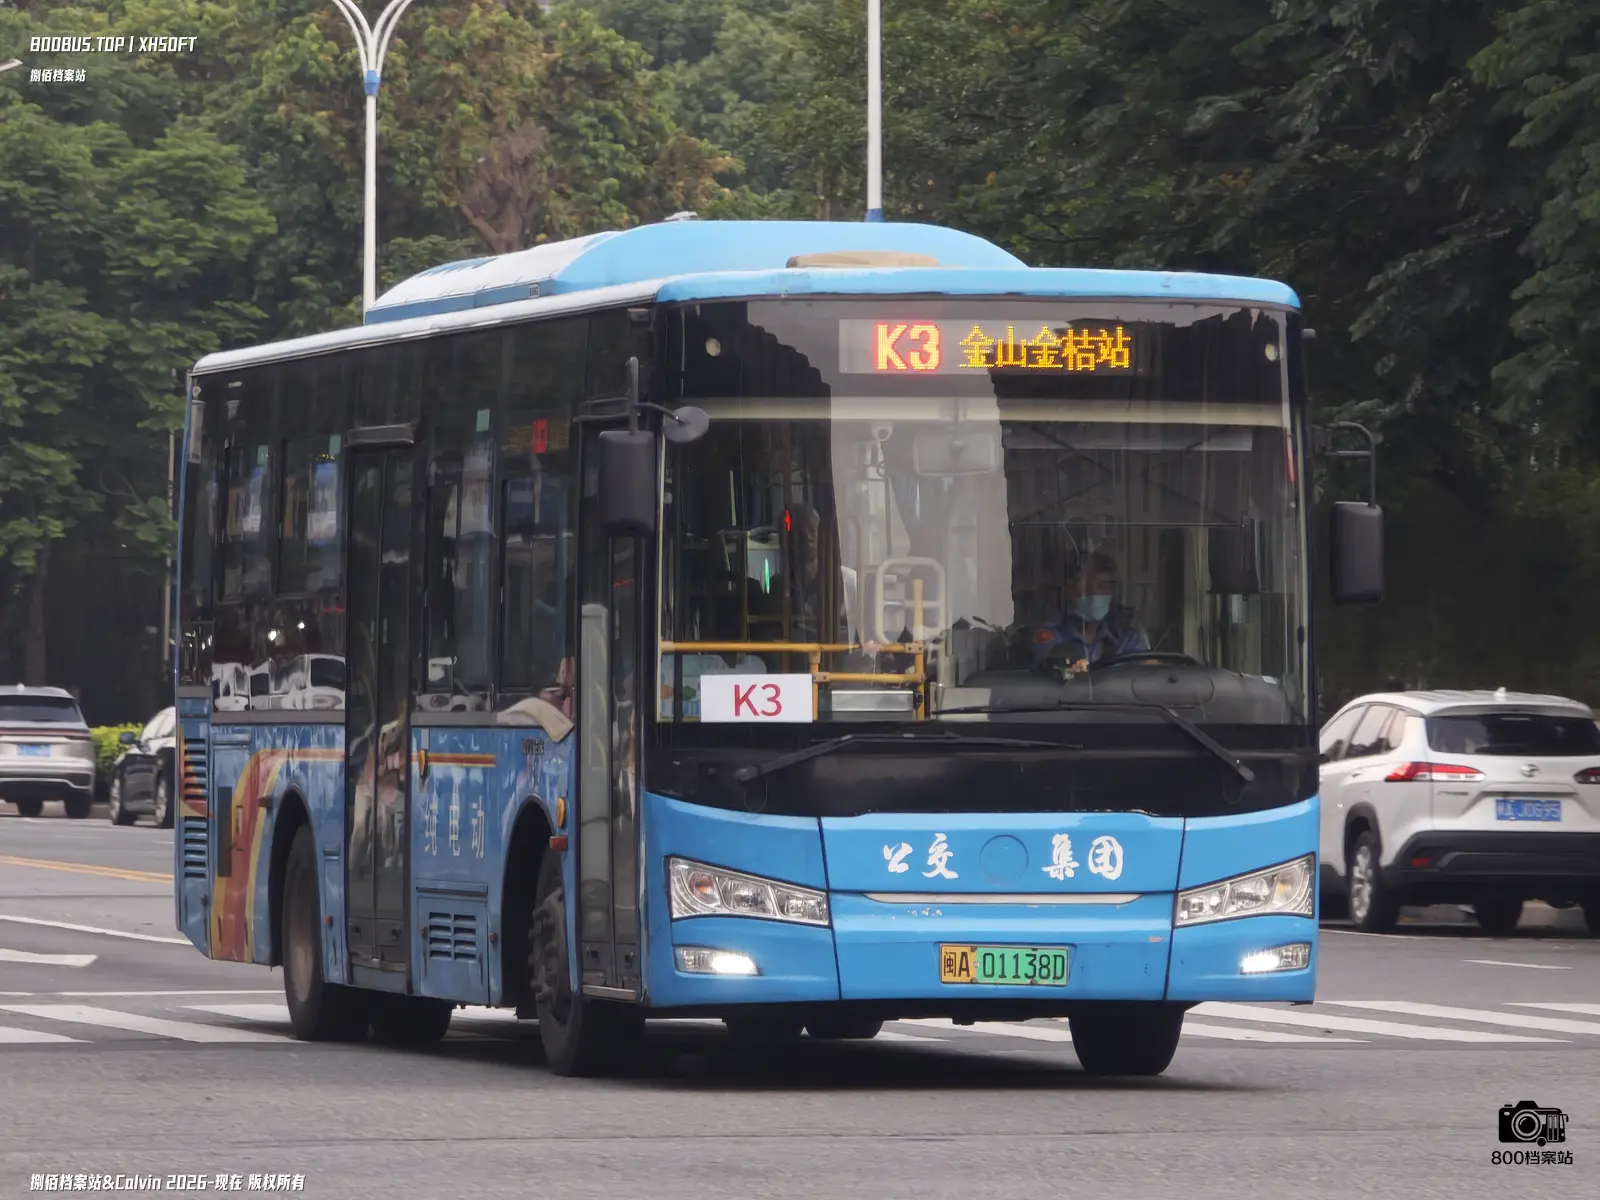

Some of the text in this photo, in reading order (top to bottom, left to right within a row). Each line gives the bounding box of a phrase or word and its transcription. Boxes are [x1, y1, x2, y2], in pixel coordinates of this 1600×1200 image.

[876, 324, 1132, 371] K3 金山金桔站
[733, 683, 783, 717] K3
[883, 833, 1124, 881] 公交 集团
